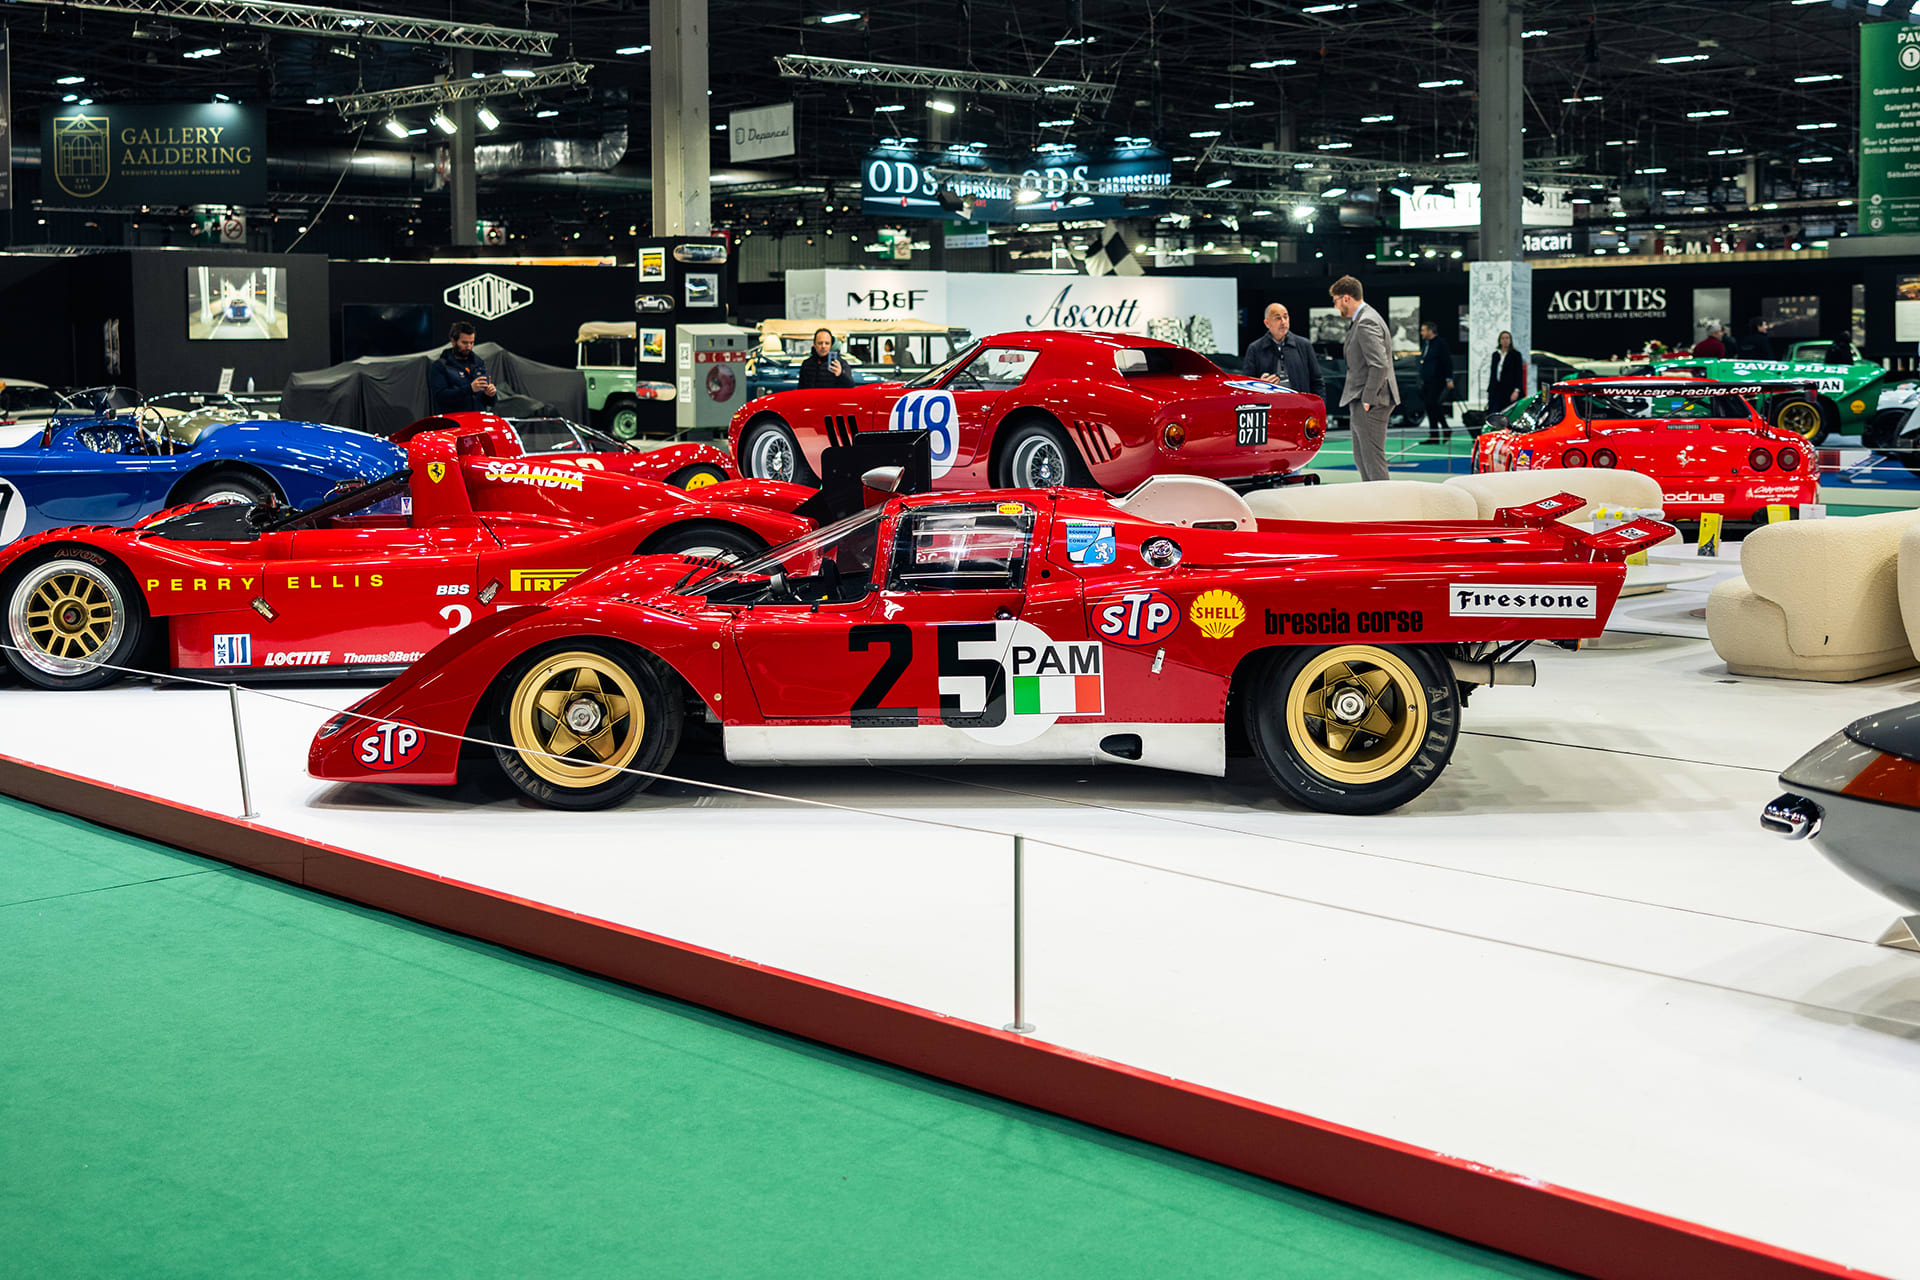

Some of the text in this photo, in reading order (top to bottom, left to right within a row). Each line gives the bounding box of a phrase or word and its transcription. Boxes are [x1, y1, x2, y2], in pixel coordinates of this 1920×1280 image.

[121, 127, 224, 145] GALLERY
[121, 146, 252, 165] AALDERING
[868, 160, 939, 196] ODS
[1019, 166, 1172, 199] ODS CARROSSERIE
[847, 289, 929, 311] MB&F
[1025, 283, 1141, 328] Ascott
[1548, 288, 1667, 312] AGUTTES
[1733, 362, 1849, 375] DAVID PIPER
[1602, 385, 1763, 397] www.care-racing.com
[895, 395, 952, 461] 118
[1239, 411, 1267, 428] CN11
[1238, 427, 1267, 444] 0711
[485, 461, 584, 491] SCANDIA
[54, 548, 107, 566] AVON
[147, 574, 384, 591] PERRY ELLIS
[436, 584, 470, 596] BBS
[1456, 590, 1590, 610] Firestone
[1100, 593, 1173, 639] STP
[1195, 607, 1240, 619] SHELL
[1264, 608, 1424, 635] brescia corse
[217, 636, 227, 664] IMSA
[264, 651, 331, 666] LOCTITE
[1012, 645, 1101, 675] PAM
[848, 623, 1007, 729] 25
[360, 722, 419, 764] STP
